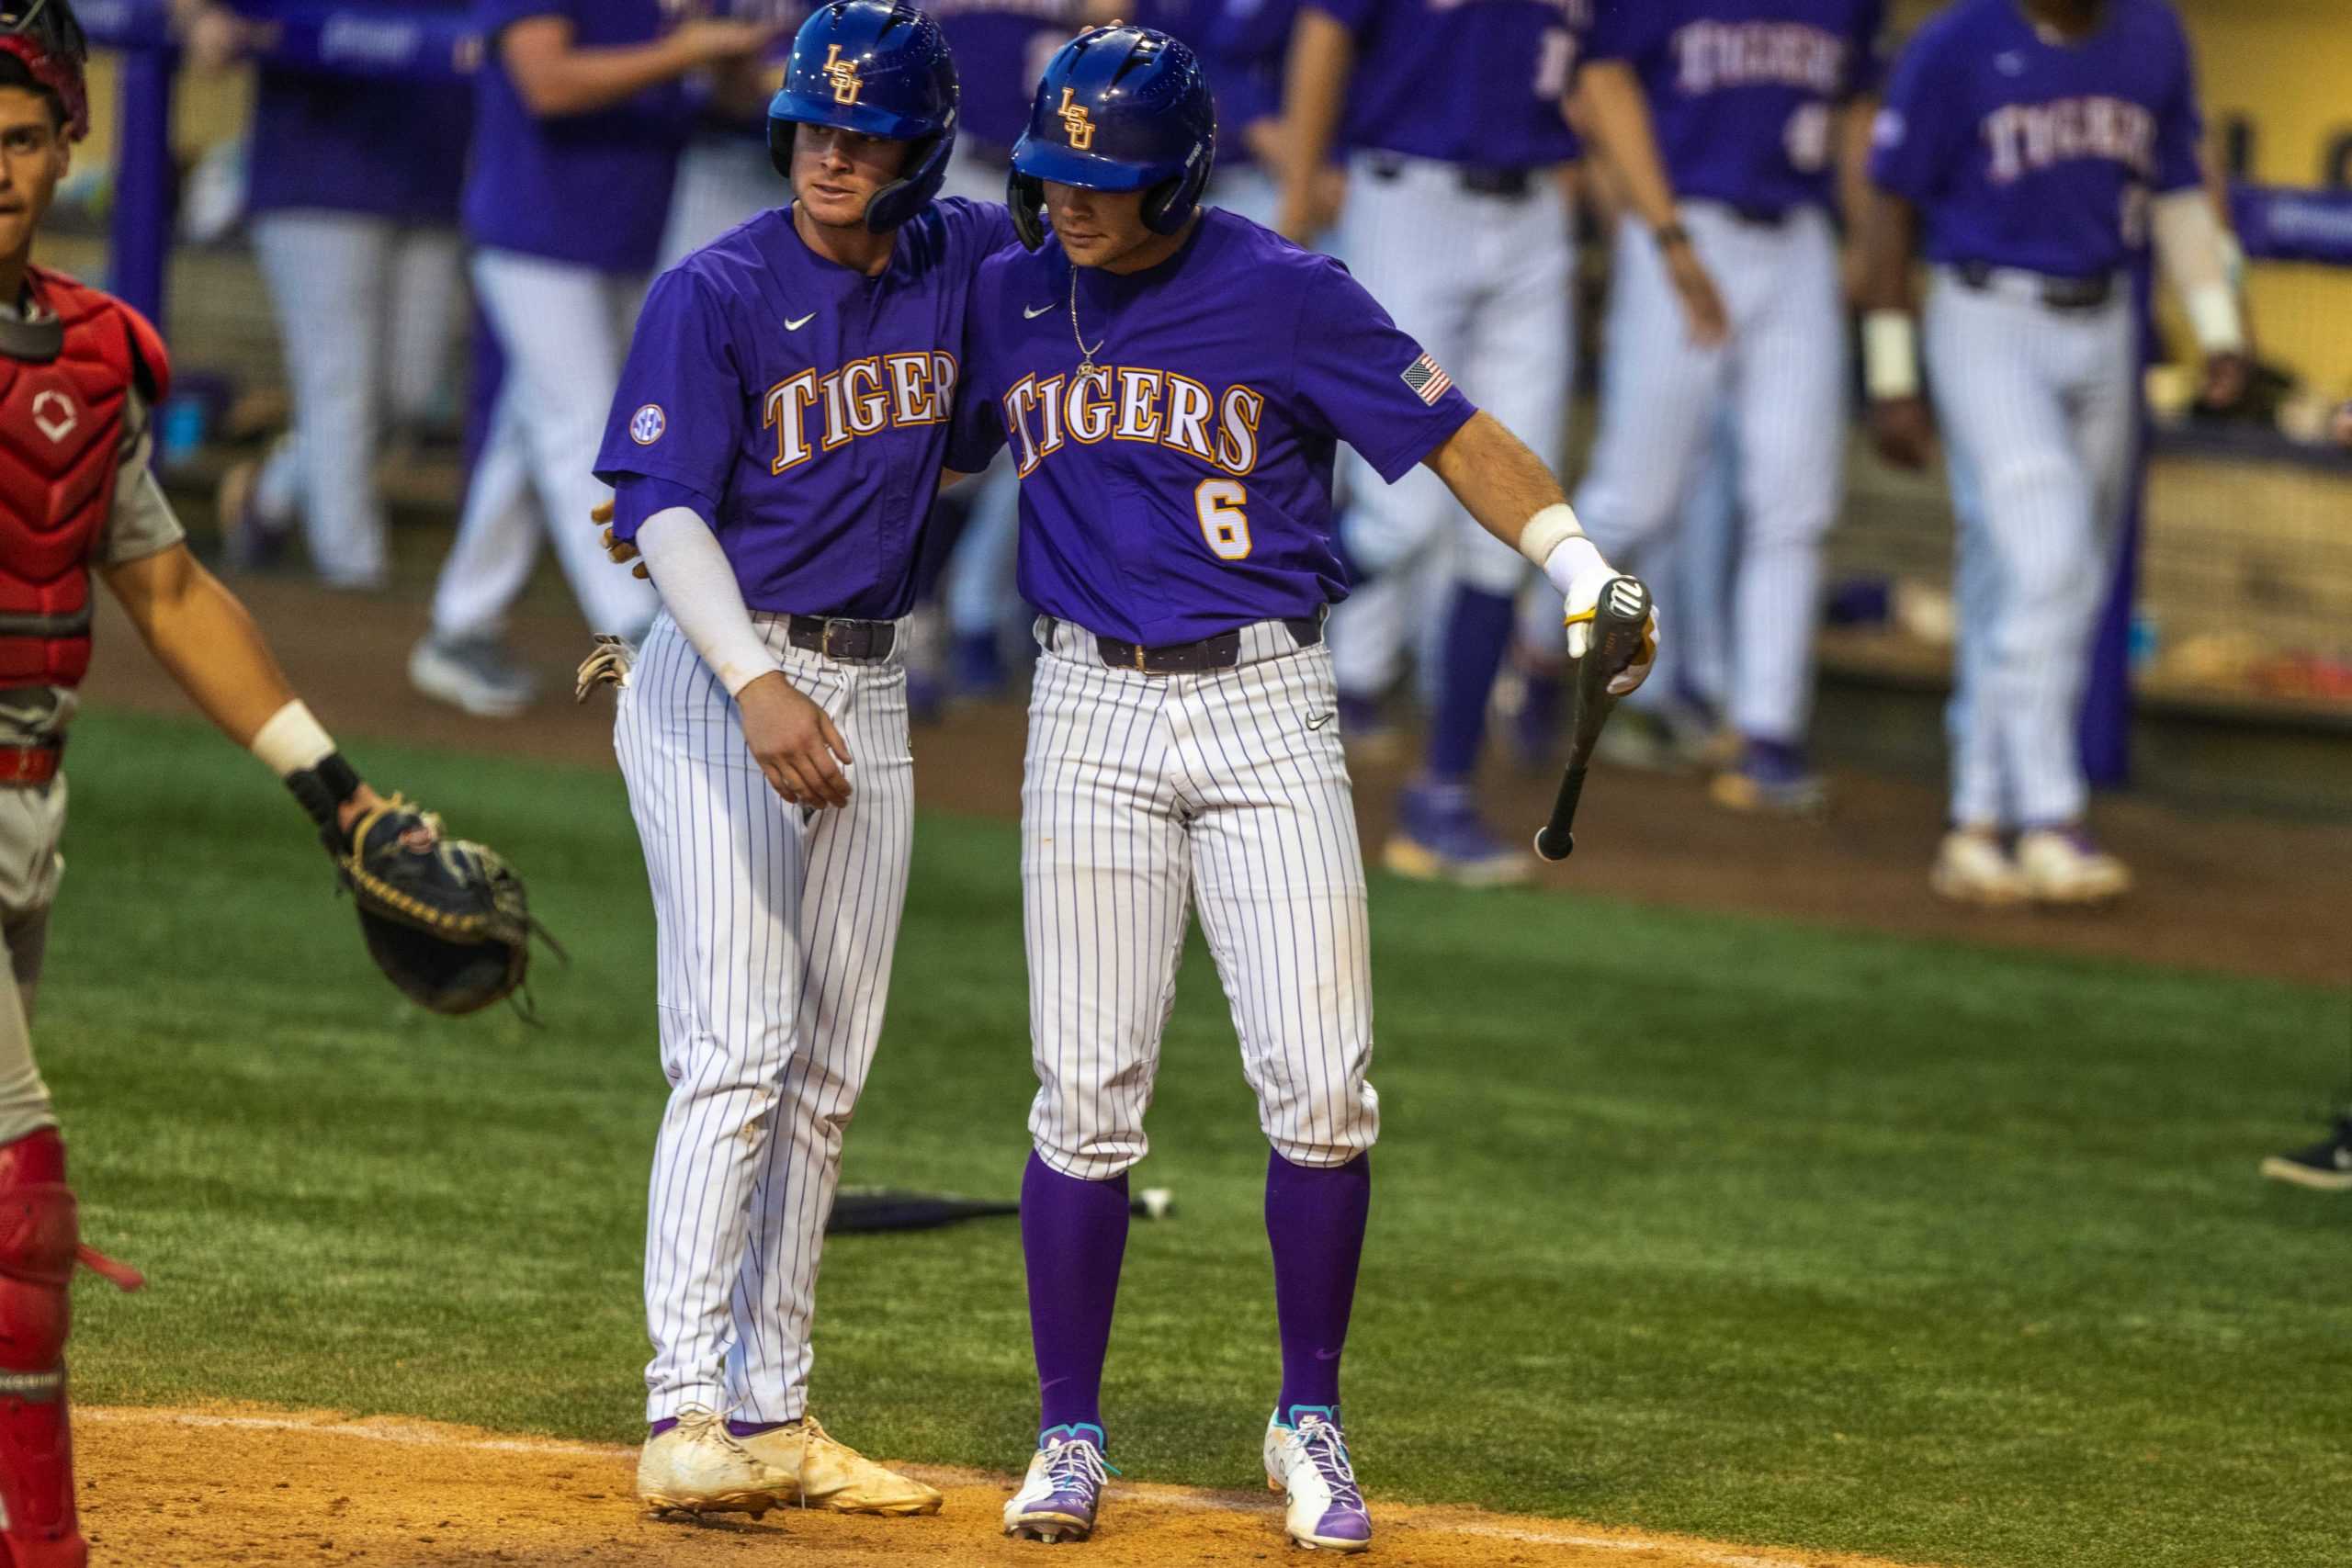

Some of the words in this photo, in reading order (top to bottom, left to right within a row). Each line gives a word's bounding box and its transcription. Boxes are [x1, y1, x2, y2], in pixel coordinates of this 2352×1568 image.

[823, 43, 864, 106] LSU
[1057, 87, 1096, 151] LSU
[1003, 366, 1264, 479] TIGERS
[1194, 478, 1252, 559] 6
